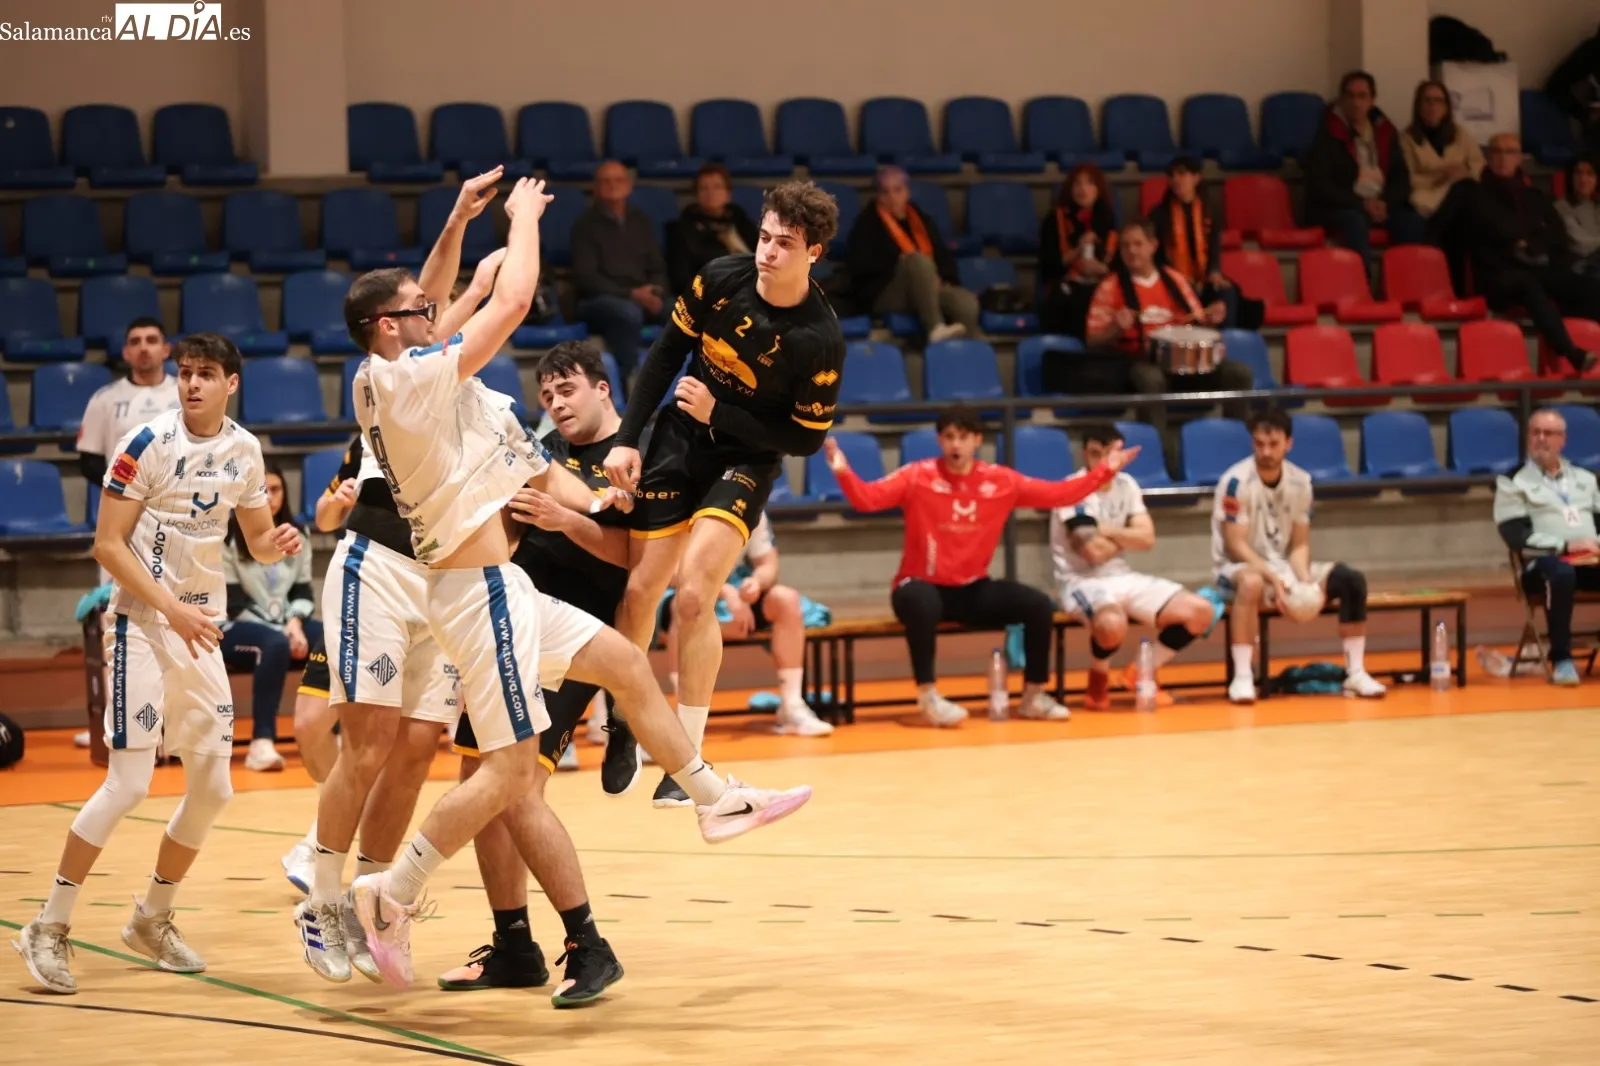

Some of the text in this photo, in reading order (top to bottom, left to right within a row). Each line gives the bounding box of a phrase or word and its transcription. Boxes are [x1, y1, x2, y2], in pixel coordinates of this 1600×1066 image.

[735, 316, 752, 337] 2
[175, 456, 186, 479] 4
[344, 582, 356, 684] www.turyva.com
[499, 617, 525, 721] www.turyva.com
[115, 641, 124, 733] www.turyva.com
